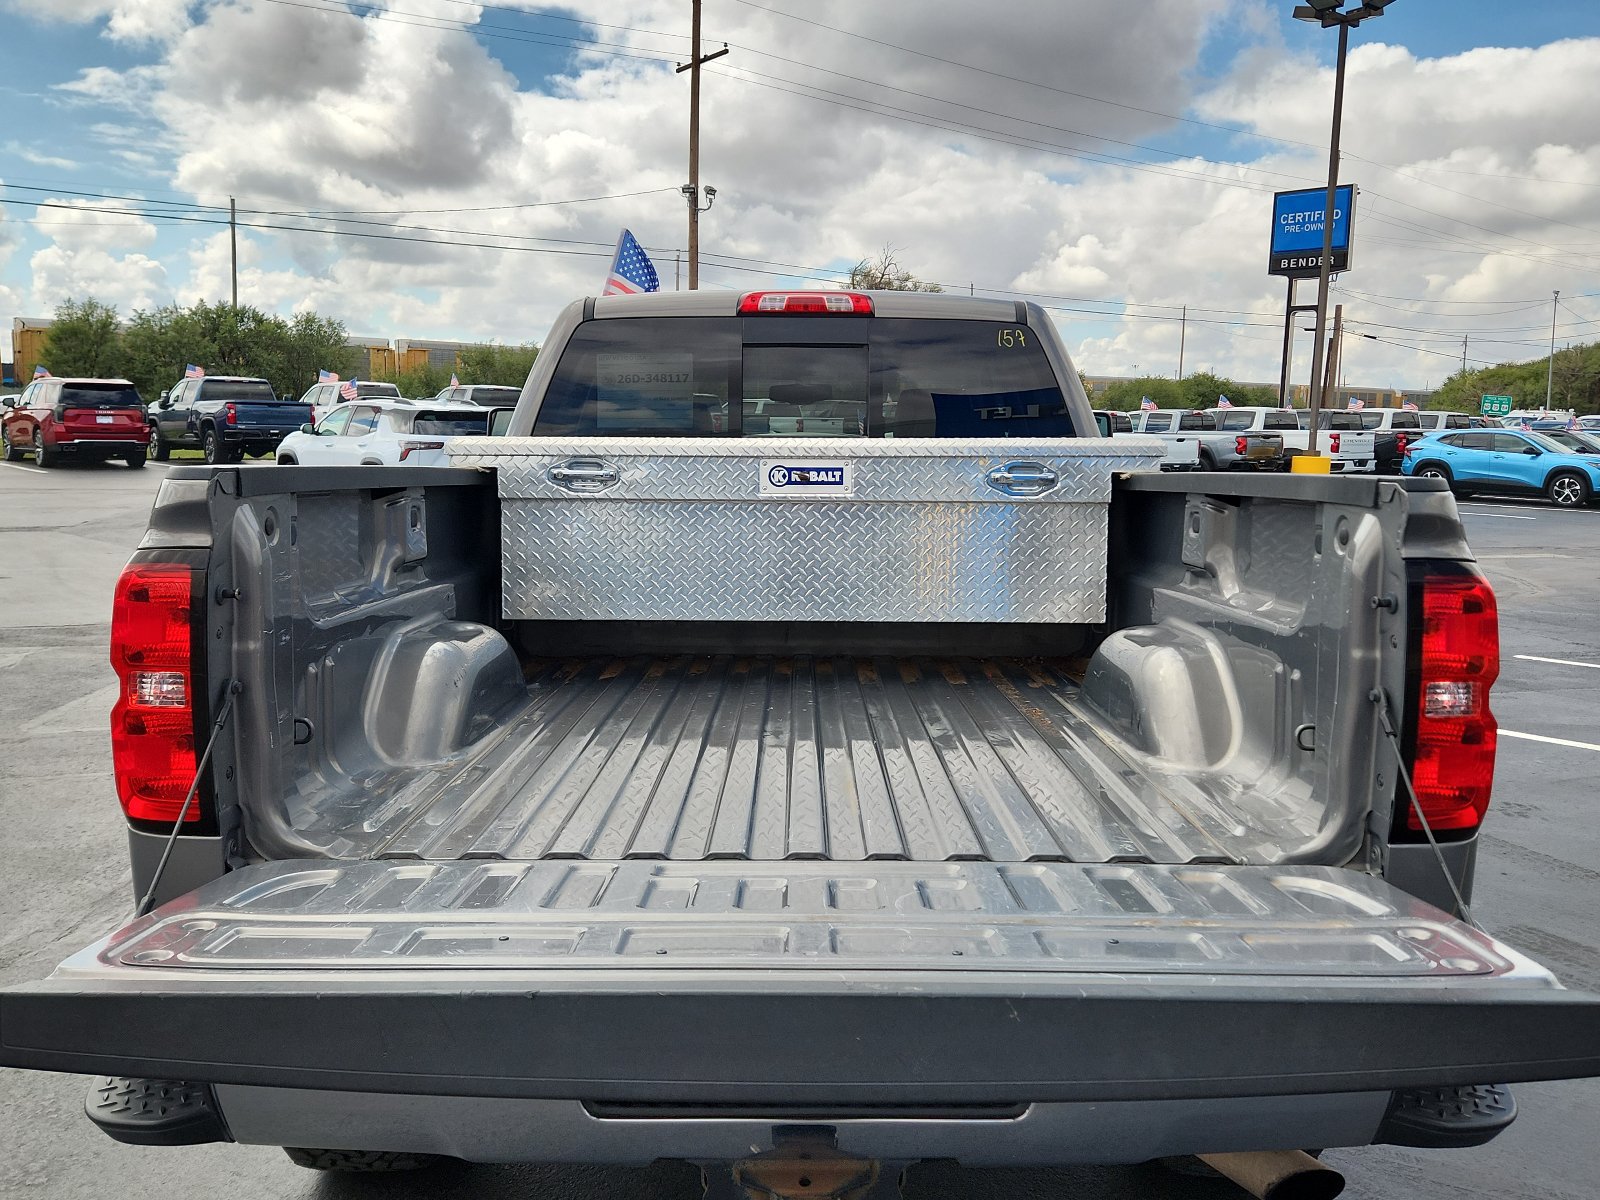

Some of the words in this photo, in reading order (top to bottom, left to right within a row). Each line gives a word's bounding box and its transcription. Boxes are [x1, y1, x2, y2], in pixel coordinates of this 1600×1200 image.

[1281, 209, 1341, 224] CERTIFID
[1284, 223, 1335, 233] PRE-OWN
[998, 329, 1025, 347] 157
[617, 374, 689, 384] 26D-348117
[791, 471, 842, 482] KBALT
